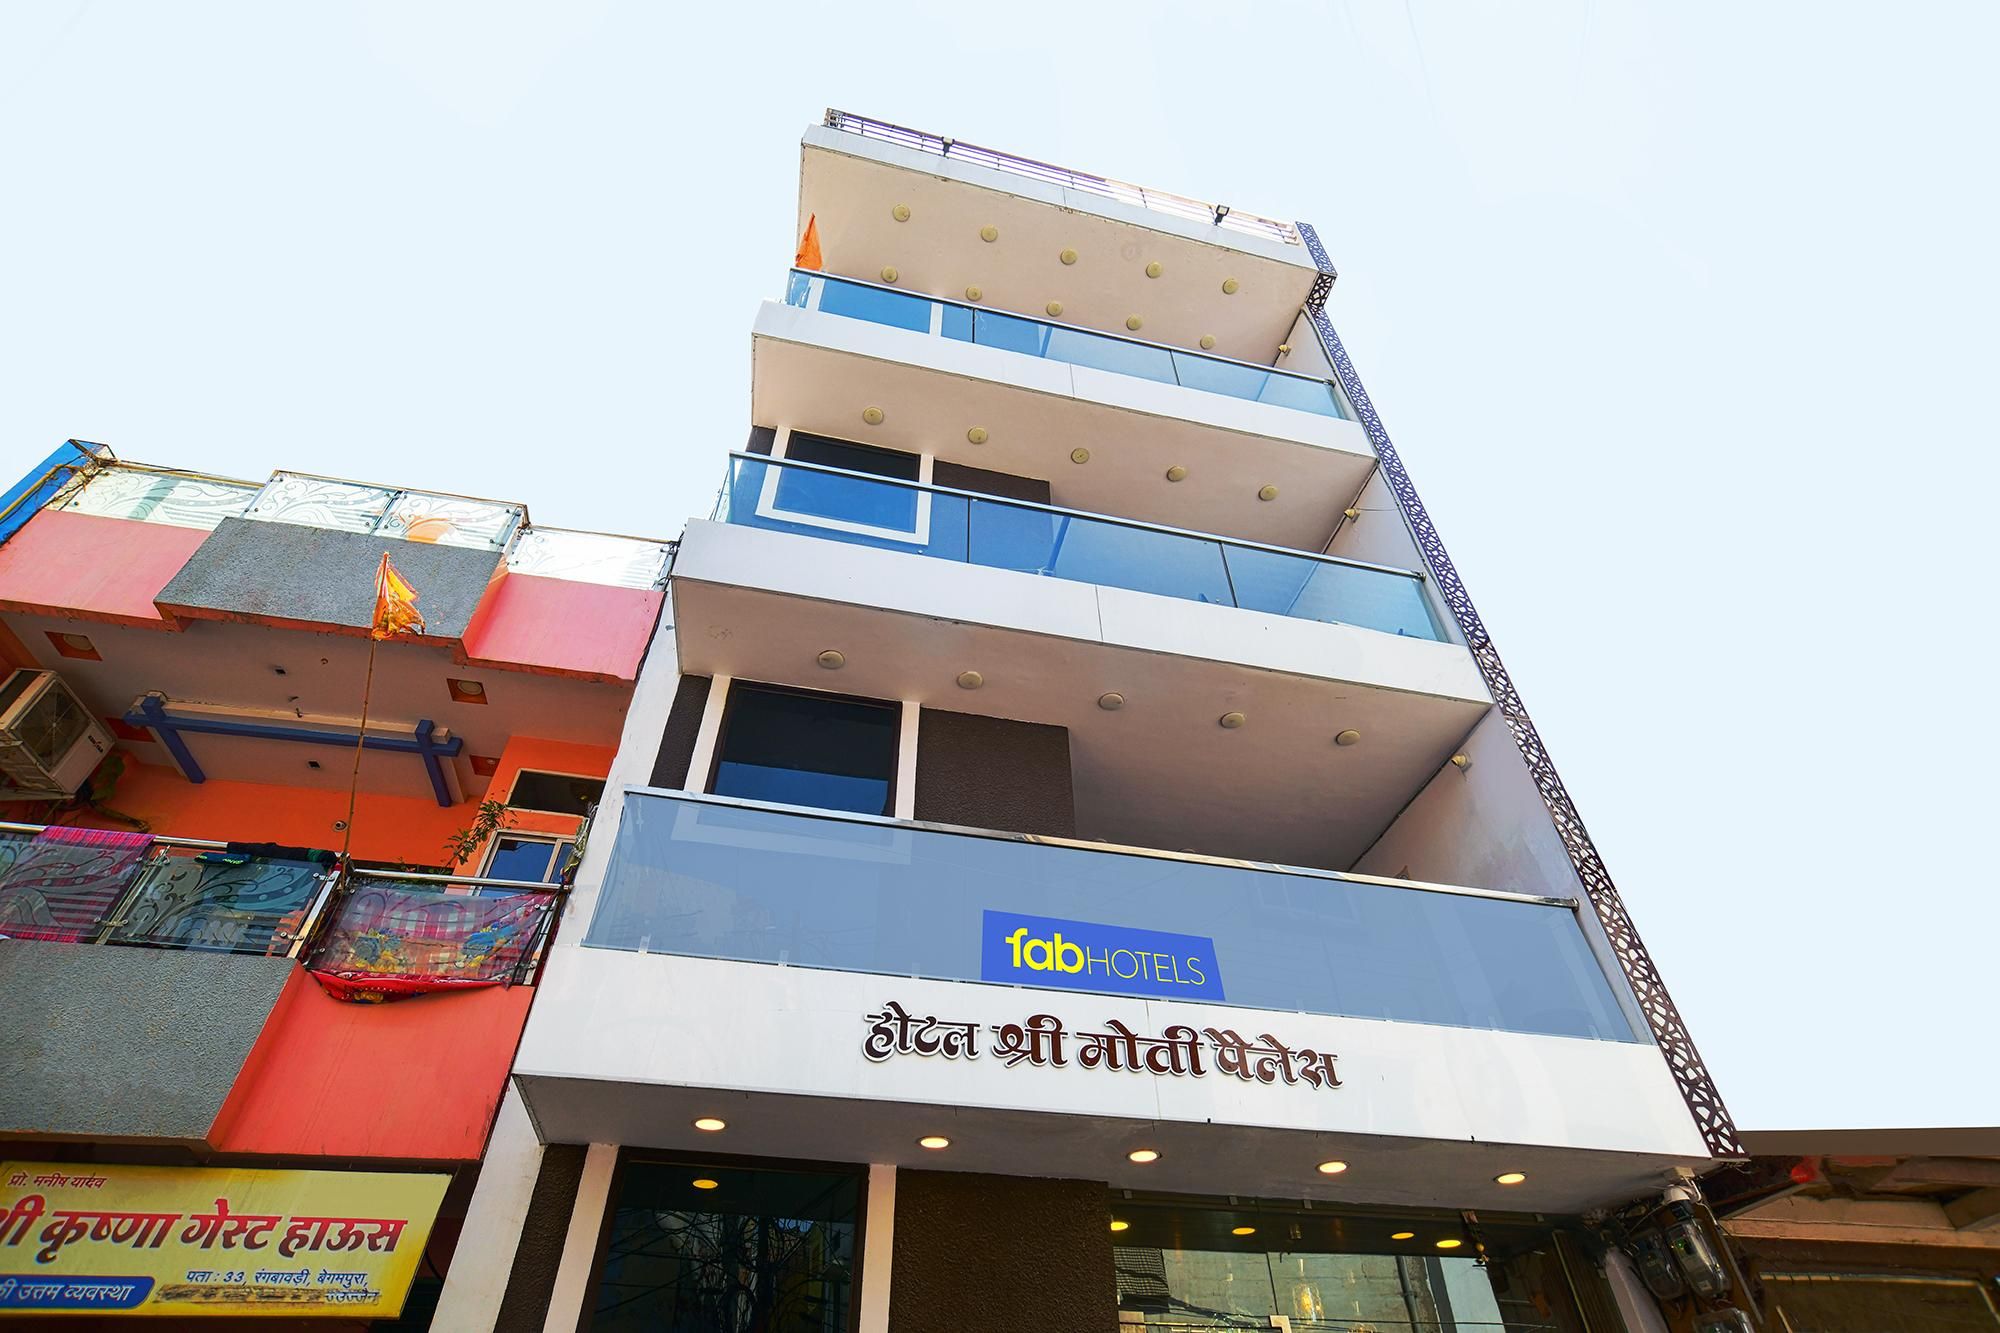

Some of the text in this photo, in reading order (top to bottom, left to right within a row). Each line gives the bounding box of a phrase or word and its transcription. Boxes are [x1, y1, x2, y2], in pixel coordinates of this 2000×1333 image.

[1005, 927, 1205, 985] fabHOTELS
[862, 1000, 1343, 1089] होटल श्री मोती पैलेस
[33, 1172, 70, 1187] मनीष
[36, 1211, 184, 1264] कृष्णा
[180, 1199, 282, 1250] गेस्ट
[278, 1216, 408, 1258] हाऊस
[64, 1285, 135, 1301] व्यवस्था
[317, 1269, 368, 1288] बेगमपुरा,
